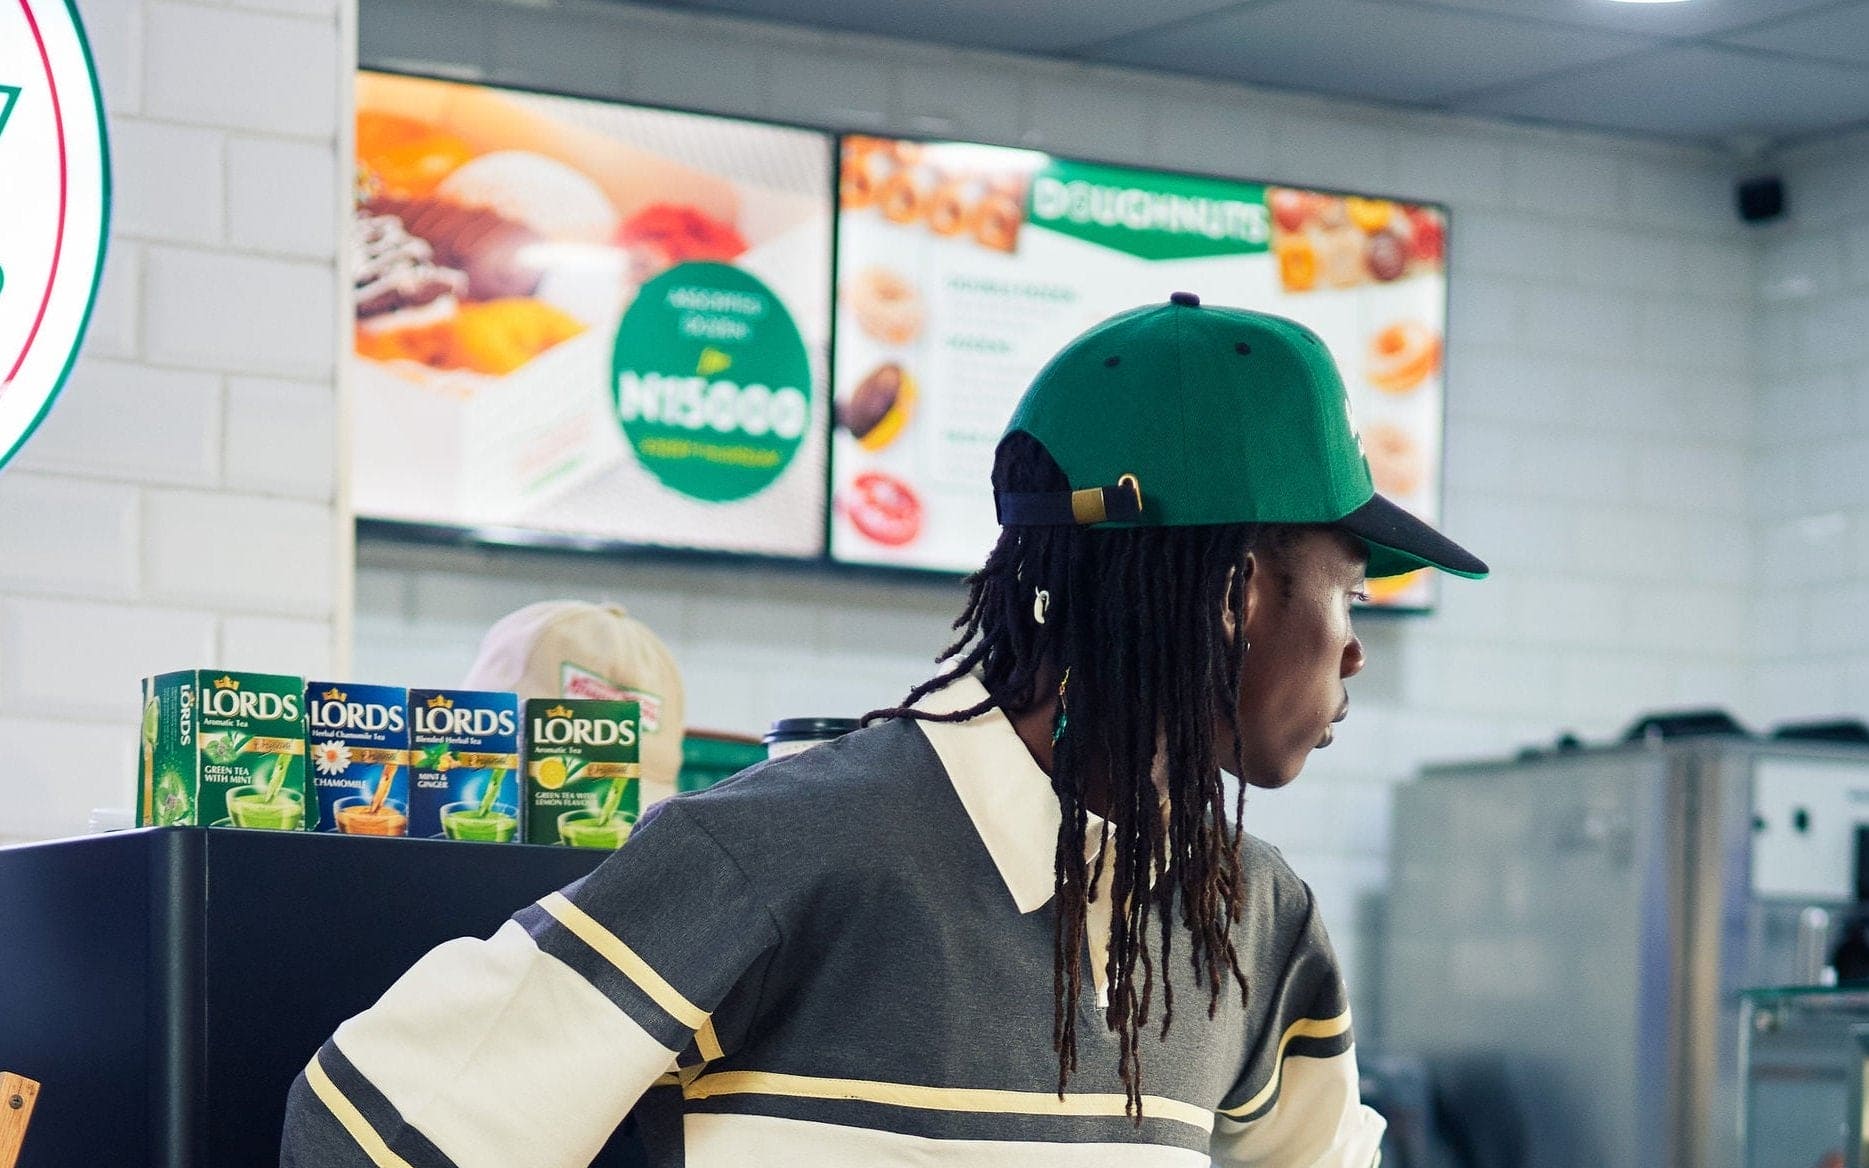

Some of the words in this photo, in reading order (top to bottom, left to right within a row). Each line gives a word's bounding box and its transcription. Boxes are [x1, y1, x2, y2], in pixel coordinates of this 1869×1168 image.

[1034, 177, 1269, 244] DOUGHNUTS
[203, 688, 299, 722] LORDS
[180, 684, 192, 746] LORDS
[311, 700, 405, 733] LORDS
[203, 717, 234, 727] Aromatic
[236, 719, 249, 728] Tea
[415, 707, 516, 736] LORDS
[312, 729, 335, 738] Herbal
[533, 718, 636, 747] LORDS
[470, 737, 482, 745] Tea
[204, 765, 233, 774] GREEN
[234, 767, 250, 776] TEA
[204, 774, 229, 783] WITH
[230, 776, 252, 785] MINT
[418, 773, 439, 781] MINT
[534, 791, 561, 799] GREEN
